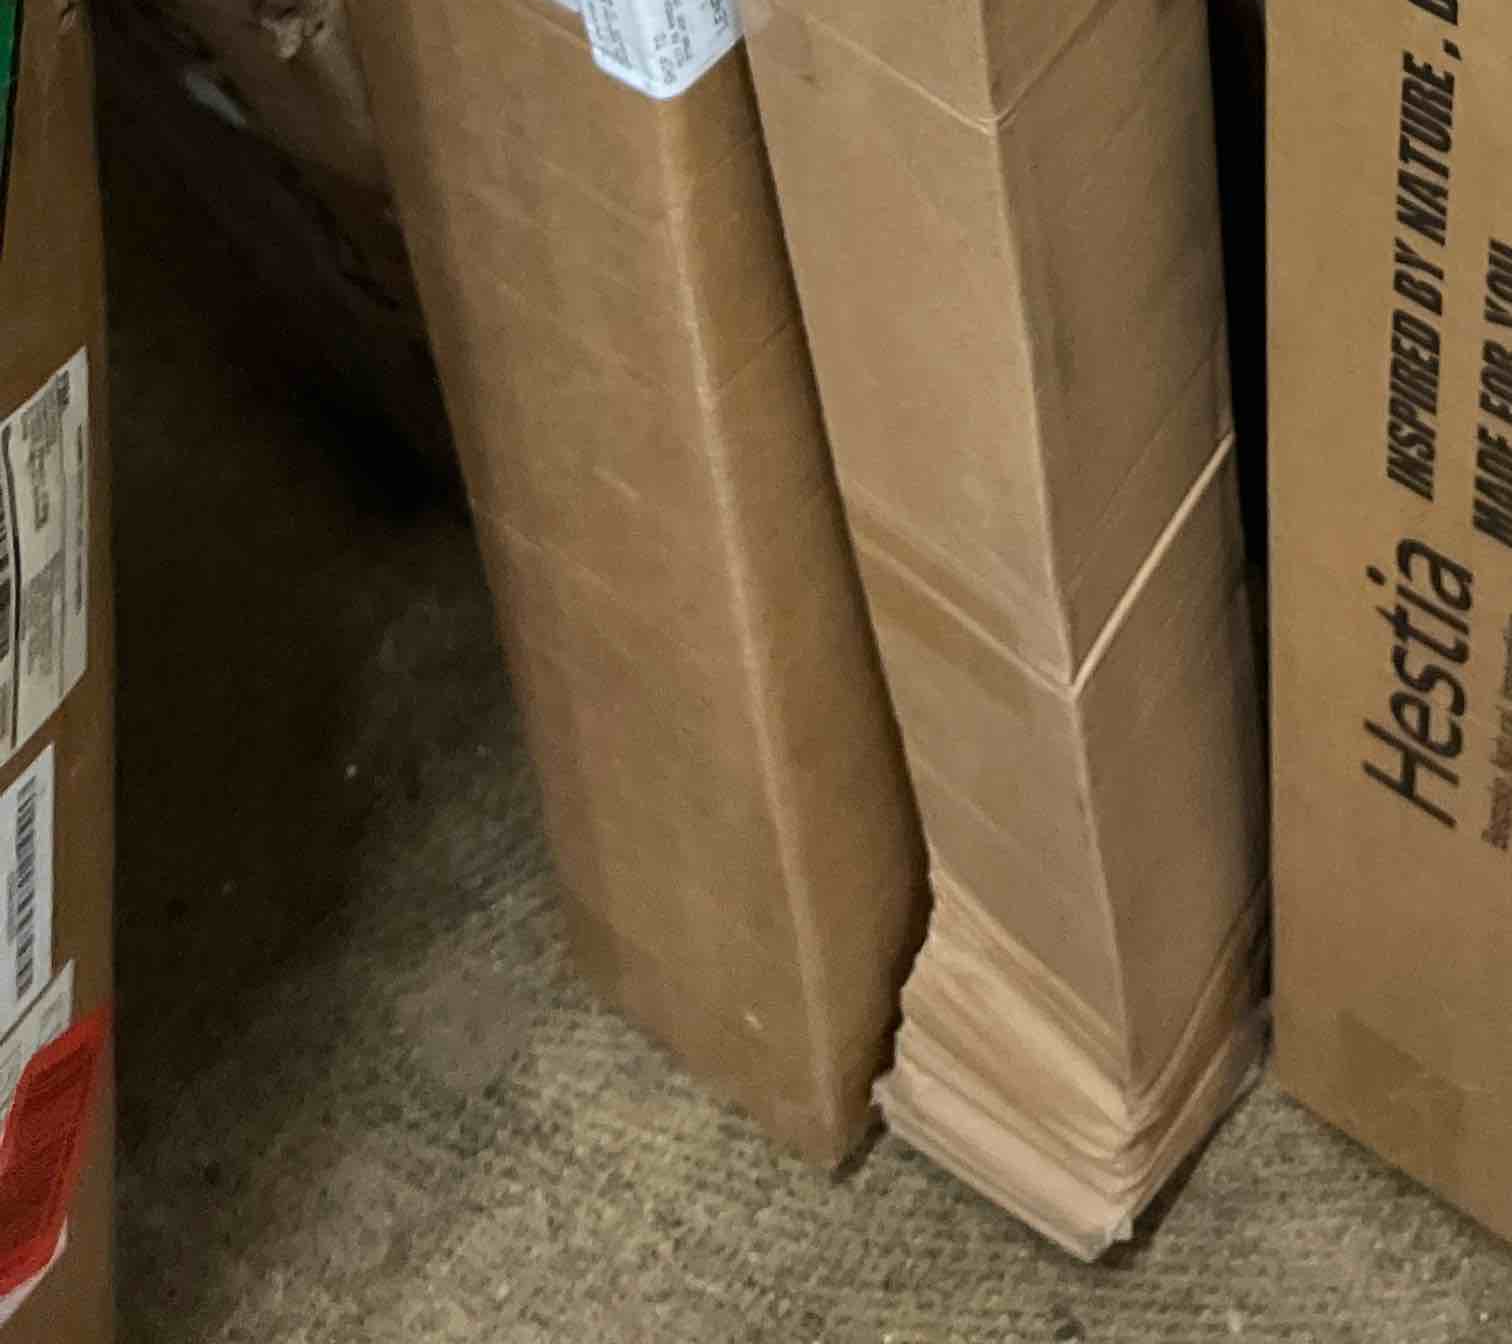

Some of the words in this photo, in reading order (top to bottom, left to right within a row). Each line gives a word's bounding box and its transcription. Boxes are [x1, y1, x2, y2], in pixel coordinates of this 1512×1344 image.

[1393, 236, 1445, 317] BY
[1386, 309, 1443, 501] INSPIRED
[1362, 537, 1473, 830] Hestia
